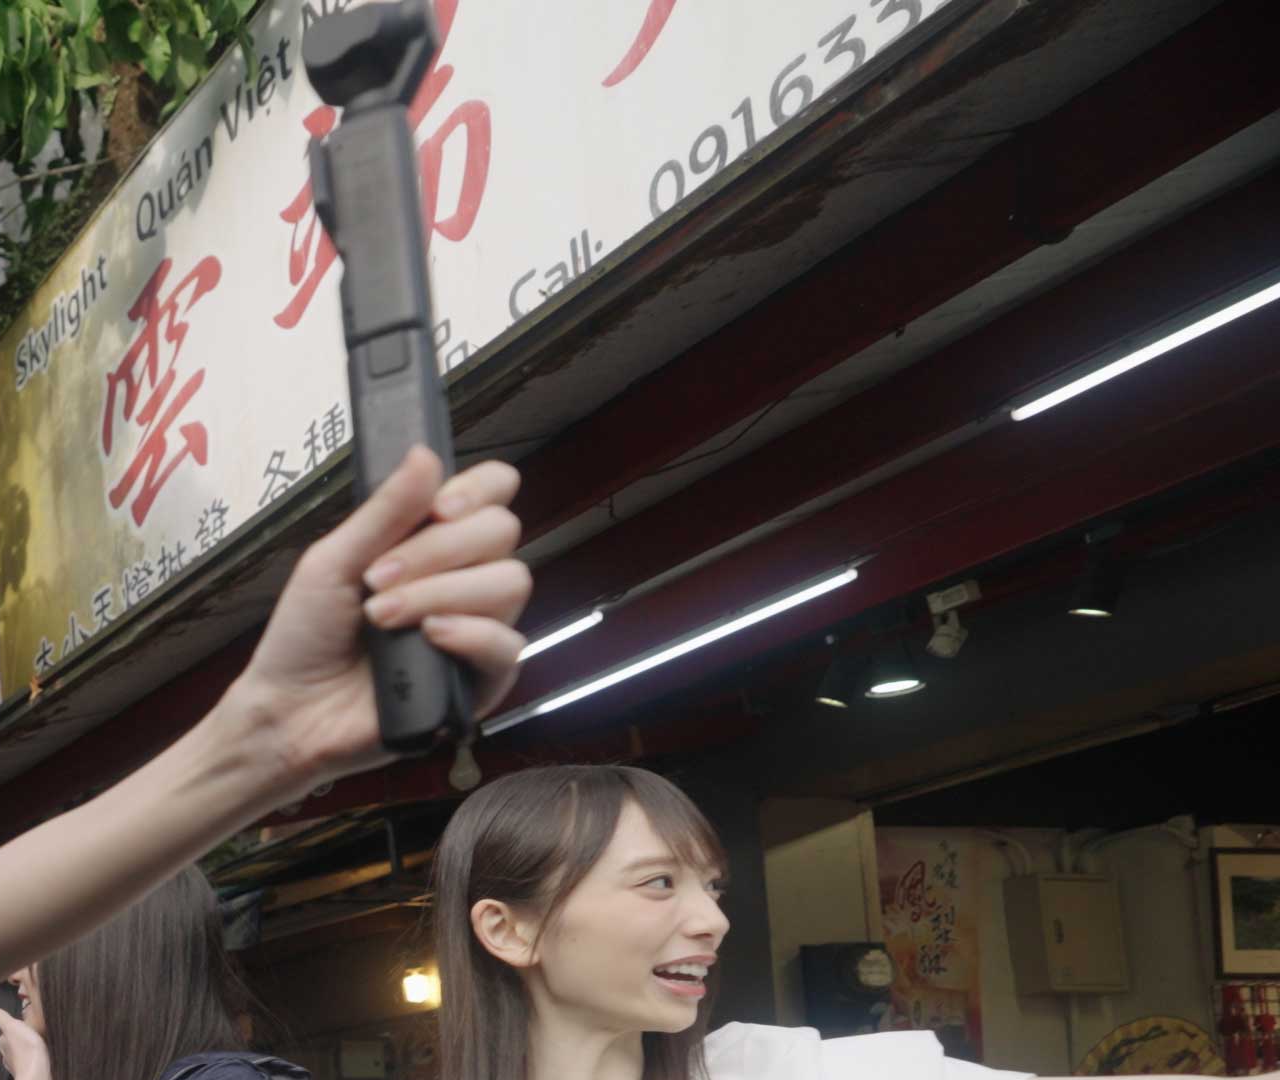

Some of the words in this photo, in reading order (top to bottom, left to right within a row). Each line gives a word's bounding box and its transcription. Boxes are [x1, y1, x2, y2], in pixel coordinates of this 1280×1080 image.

[16, 256, 108, 387] Skylight
[136, 135, 214, 241] Quán
[220, 37, 293, 142] Việt
